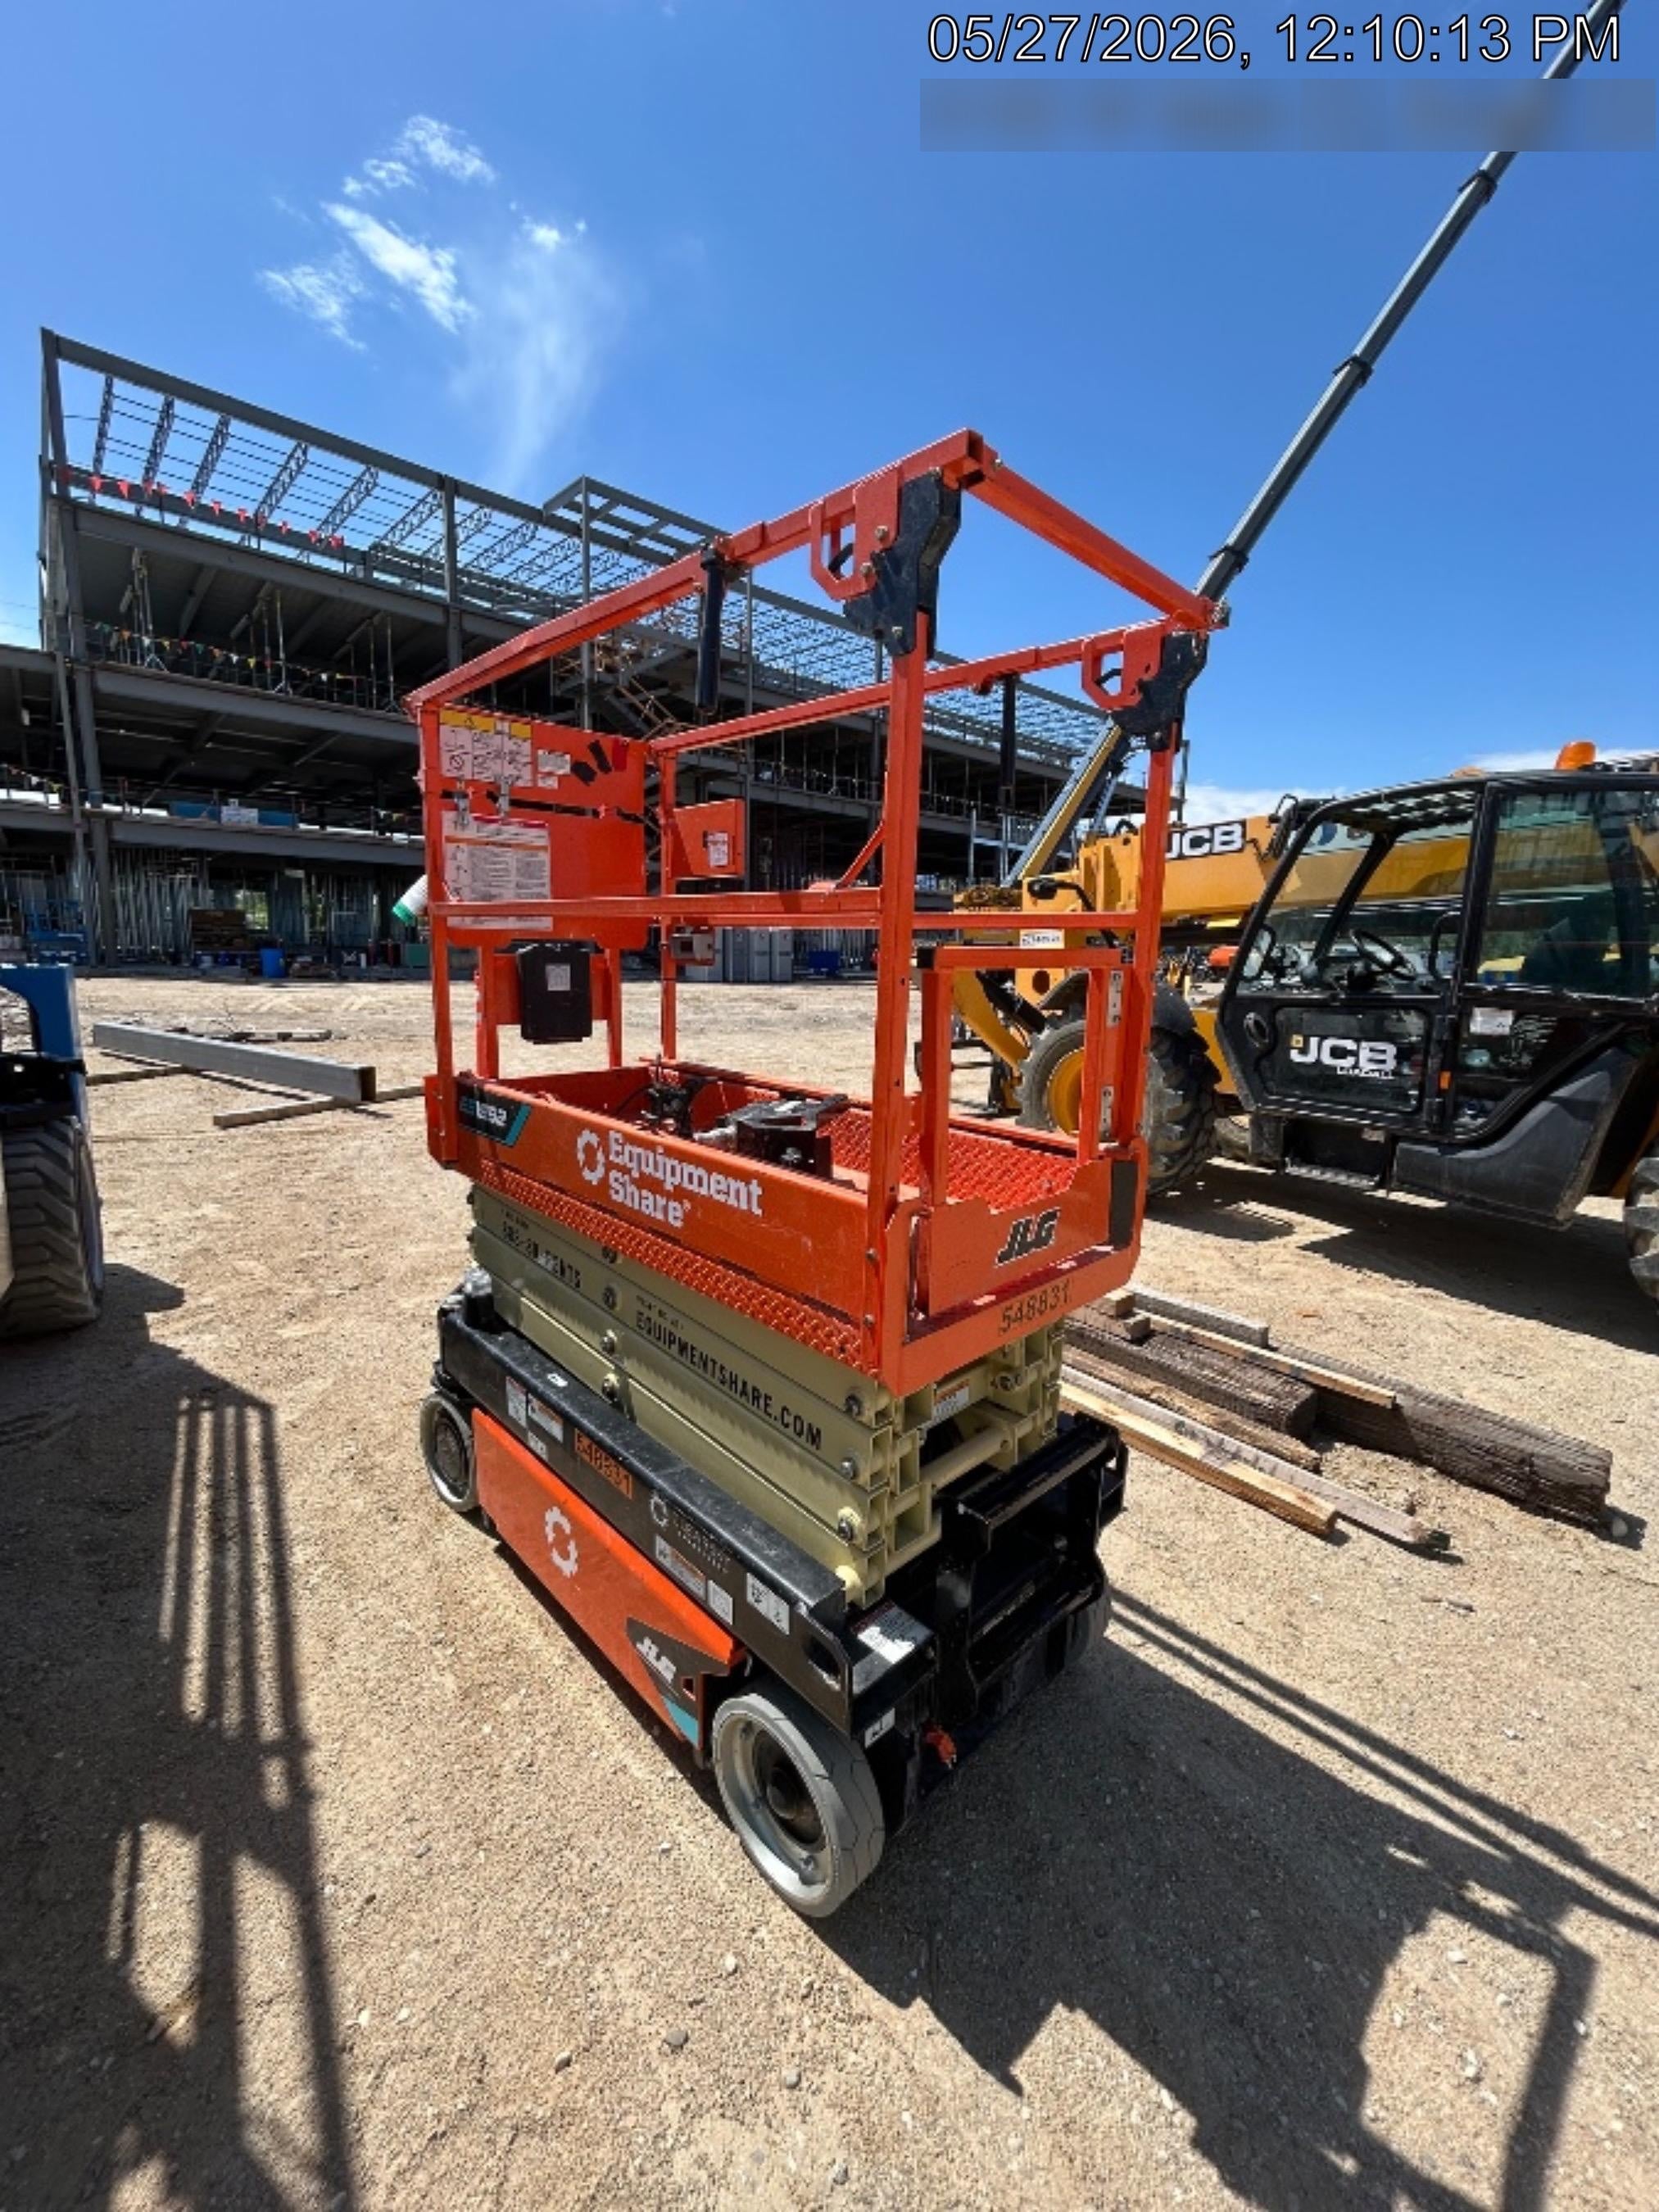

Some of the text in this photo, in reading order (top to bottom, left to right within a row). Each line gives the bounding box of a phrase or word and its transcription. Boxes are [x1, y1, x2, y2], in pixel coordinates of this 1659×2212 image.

[1165, 823, 1244, 859] JCB
[1290, 1034, 1398, 1070] JCB
[609, 1130, 763, 1217] Equipment
[994, 1207, 1063, 1267] JLG
[998, 1277, 1071, 1335] 548831
[636, 1309, 823, 1451] EQUIPMENTSHARE.COM
